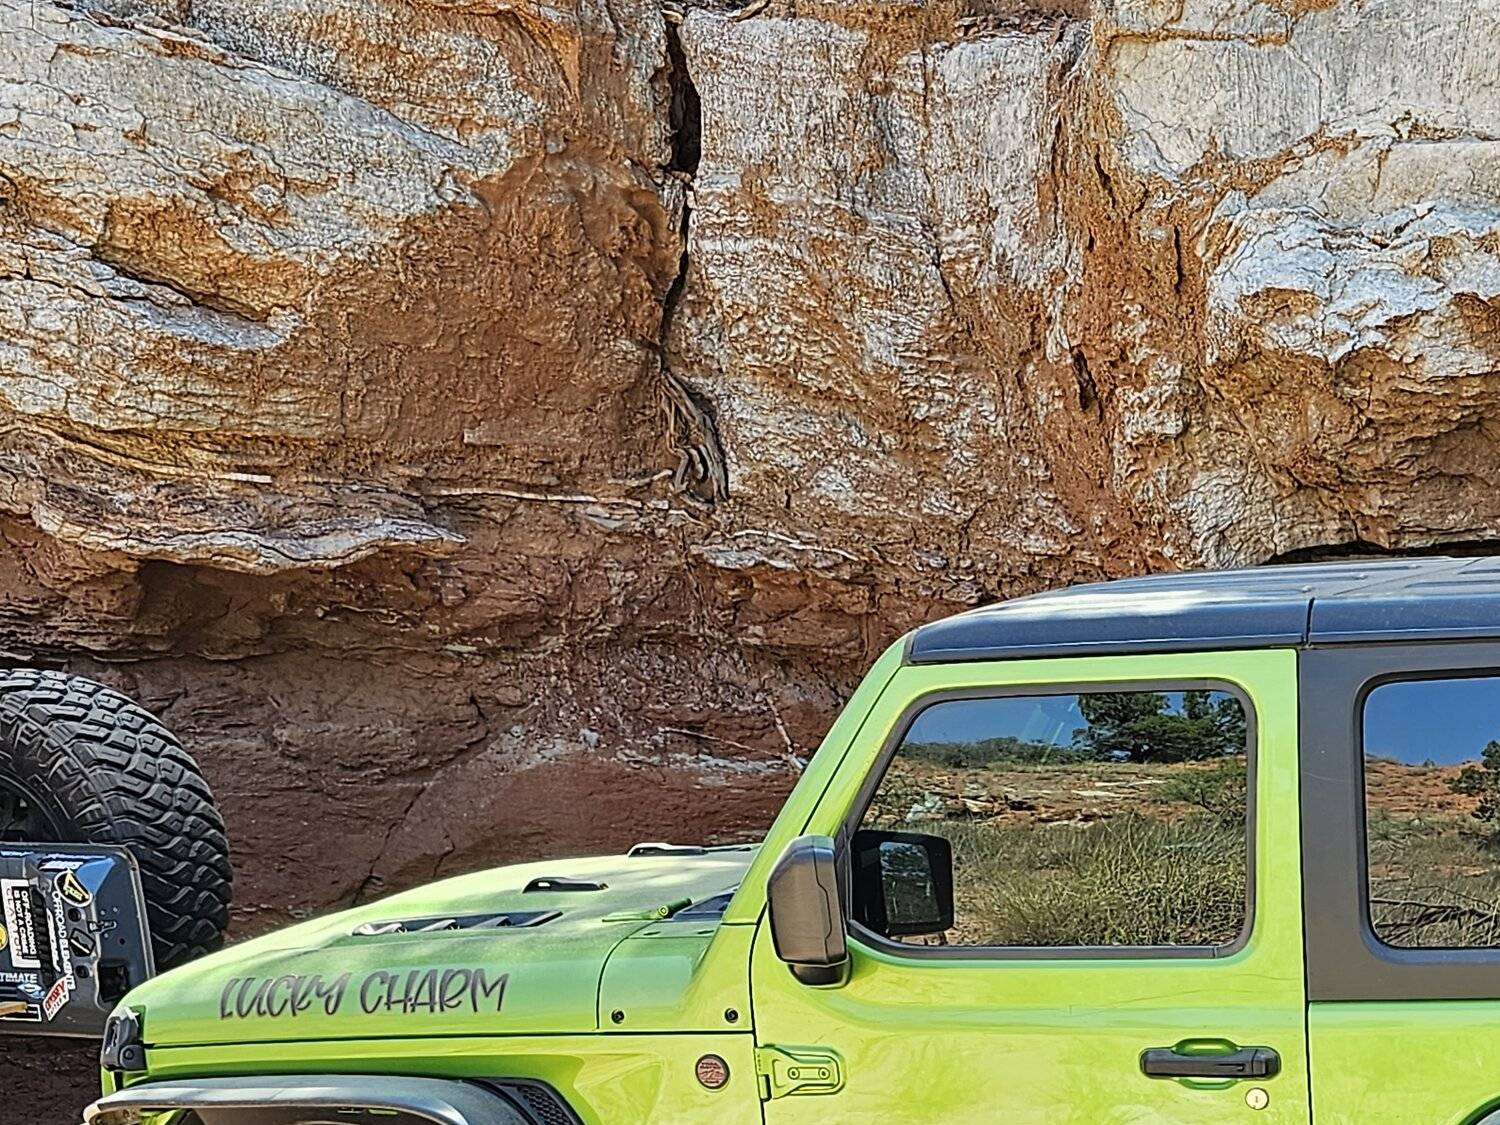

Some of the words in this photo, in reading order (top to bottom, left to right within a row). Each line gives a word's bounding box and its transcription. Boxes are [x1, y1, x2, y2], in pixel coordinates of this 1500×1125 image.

[15, 900, 23, 918] NOT
[21, 890, 37, 955] OFF-ROADING
[52, 890, 67, 938] OFFROAD
[220, 972, 352, 1020] LUCKY
[359, 968, 510, 1014] CHARM
